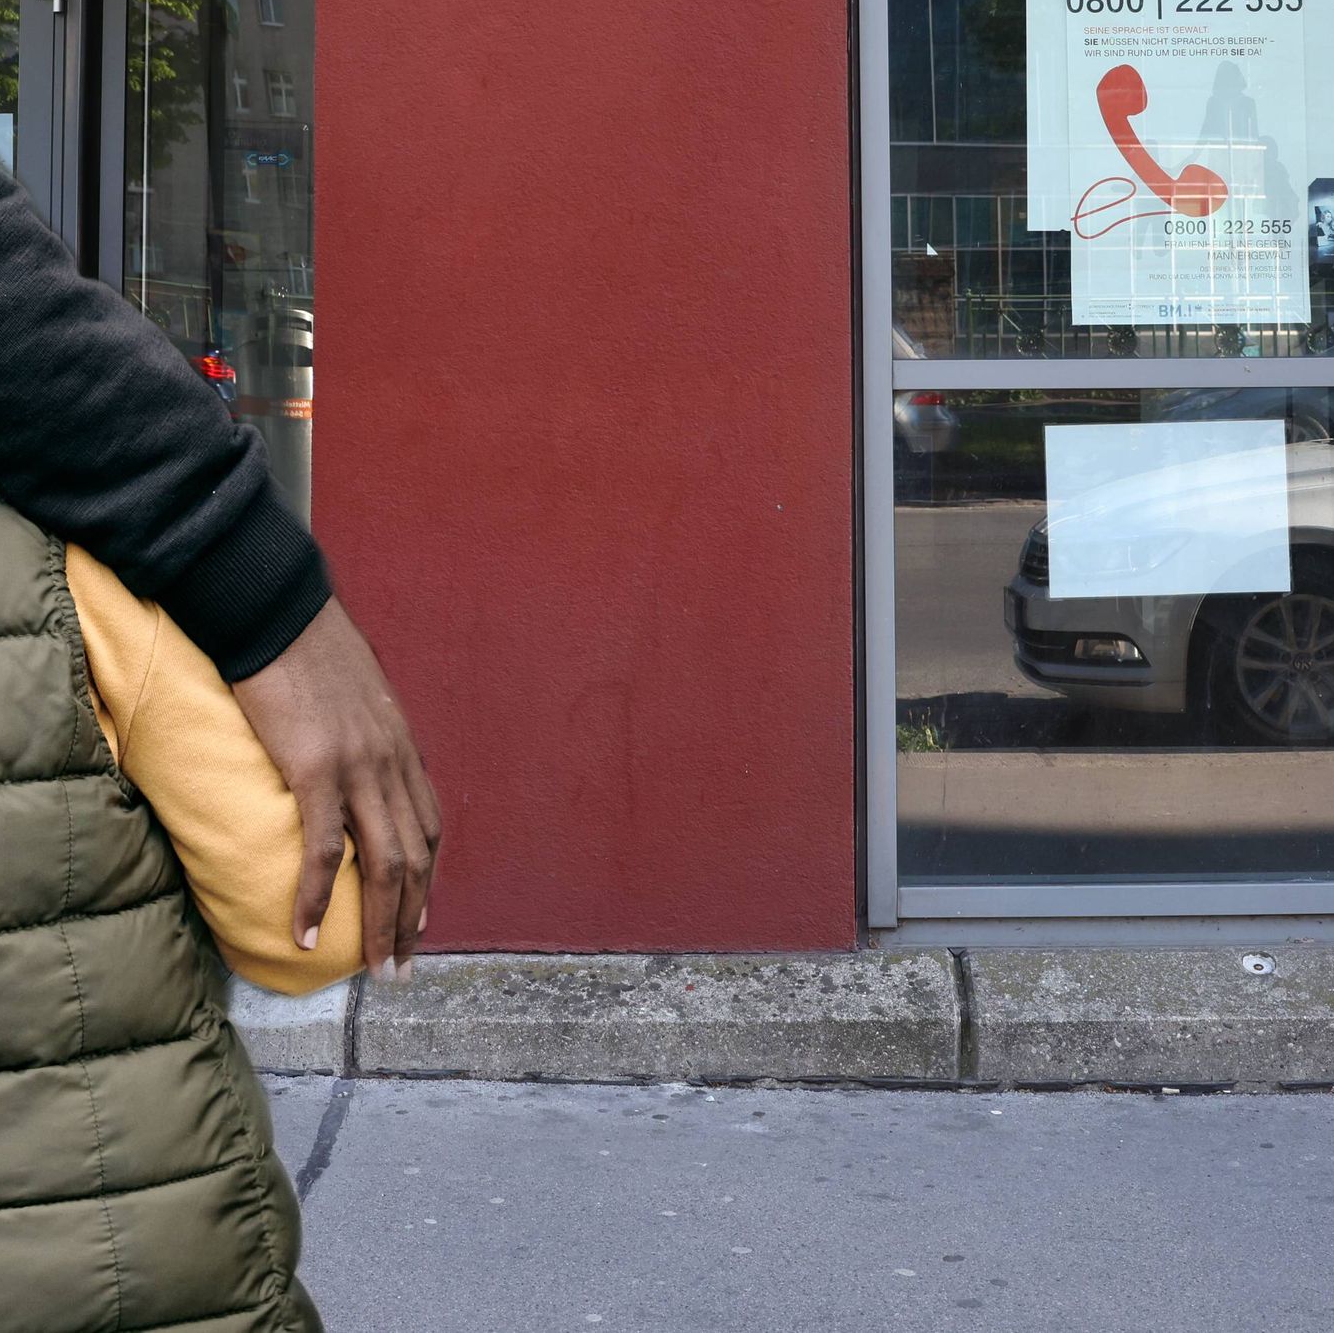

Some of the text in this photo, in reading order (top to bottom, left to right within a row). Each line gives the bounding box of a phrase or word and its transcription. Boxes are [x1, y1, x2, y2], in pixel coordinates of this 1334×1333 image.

[1083, 26, 1110, 35] SEINE
[1112, 26, 1154, 35] SPRACHE
[1156, 26, 1170, 34] IST
[1084, 38, 1099, 46] SIE
[1101, 36, 1139, 46] MÜSSEN
[1171, 37, 1225, 45] SPRACHLOS
[1084, 48, 1262, 57] WIR SIND RUND UM DIE UHR FÜR SIE DA!
[1164, 220, 1207, 235] 0800
[1223, 220, 1254, 235] 222
[1260, 219, 1292, 234] 555
[1255, 239, 1292, 248] GEGEN
